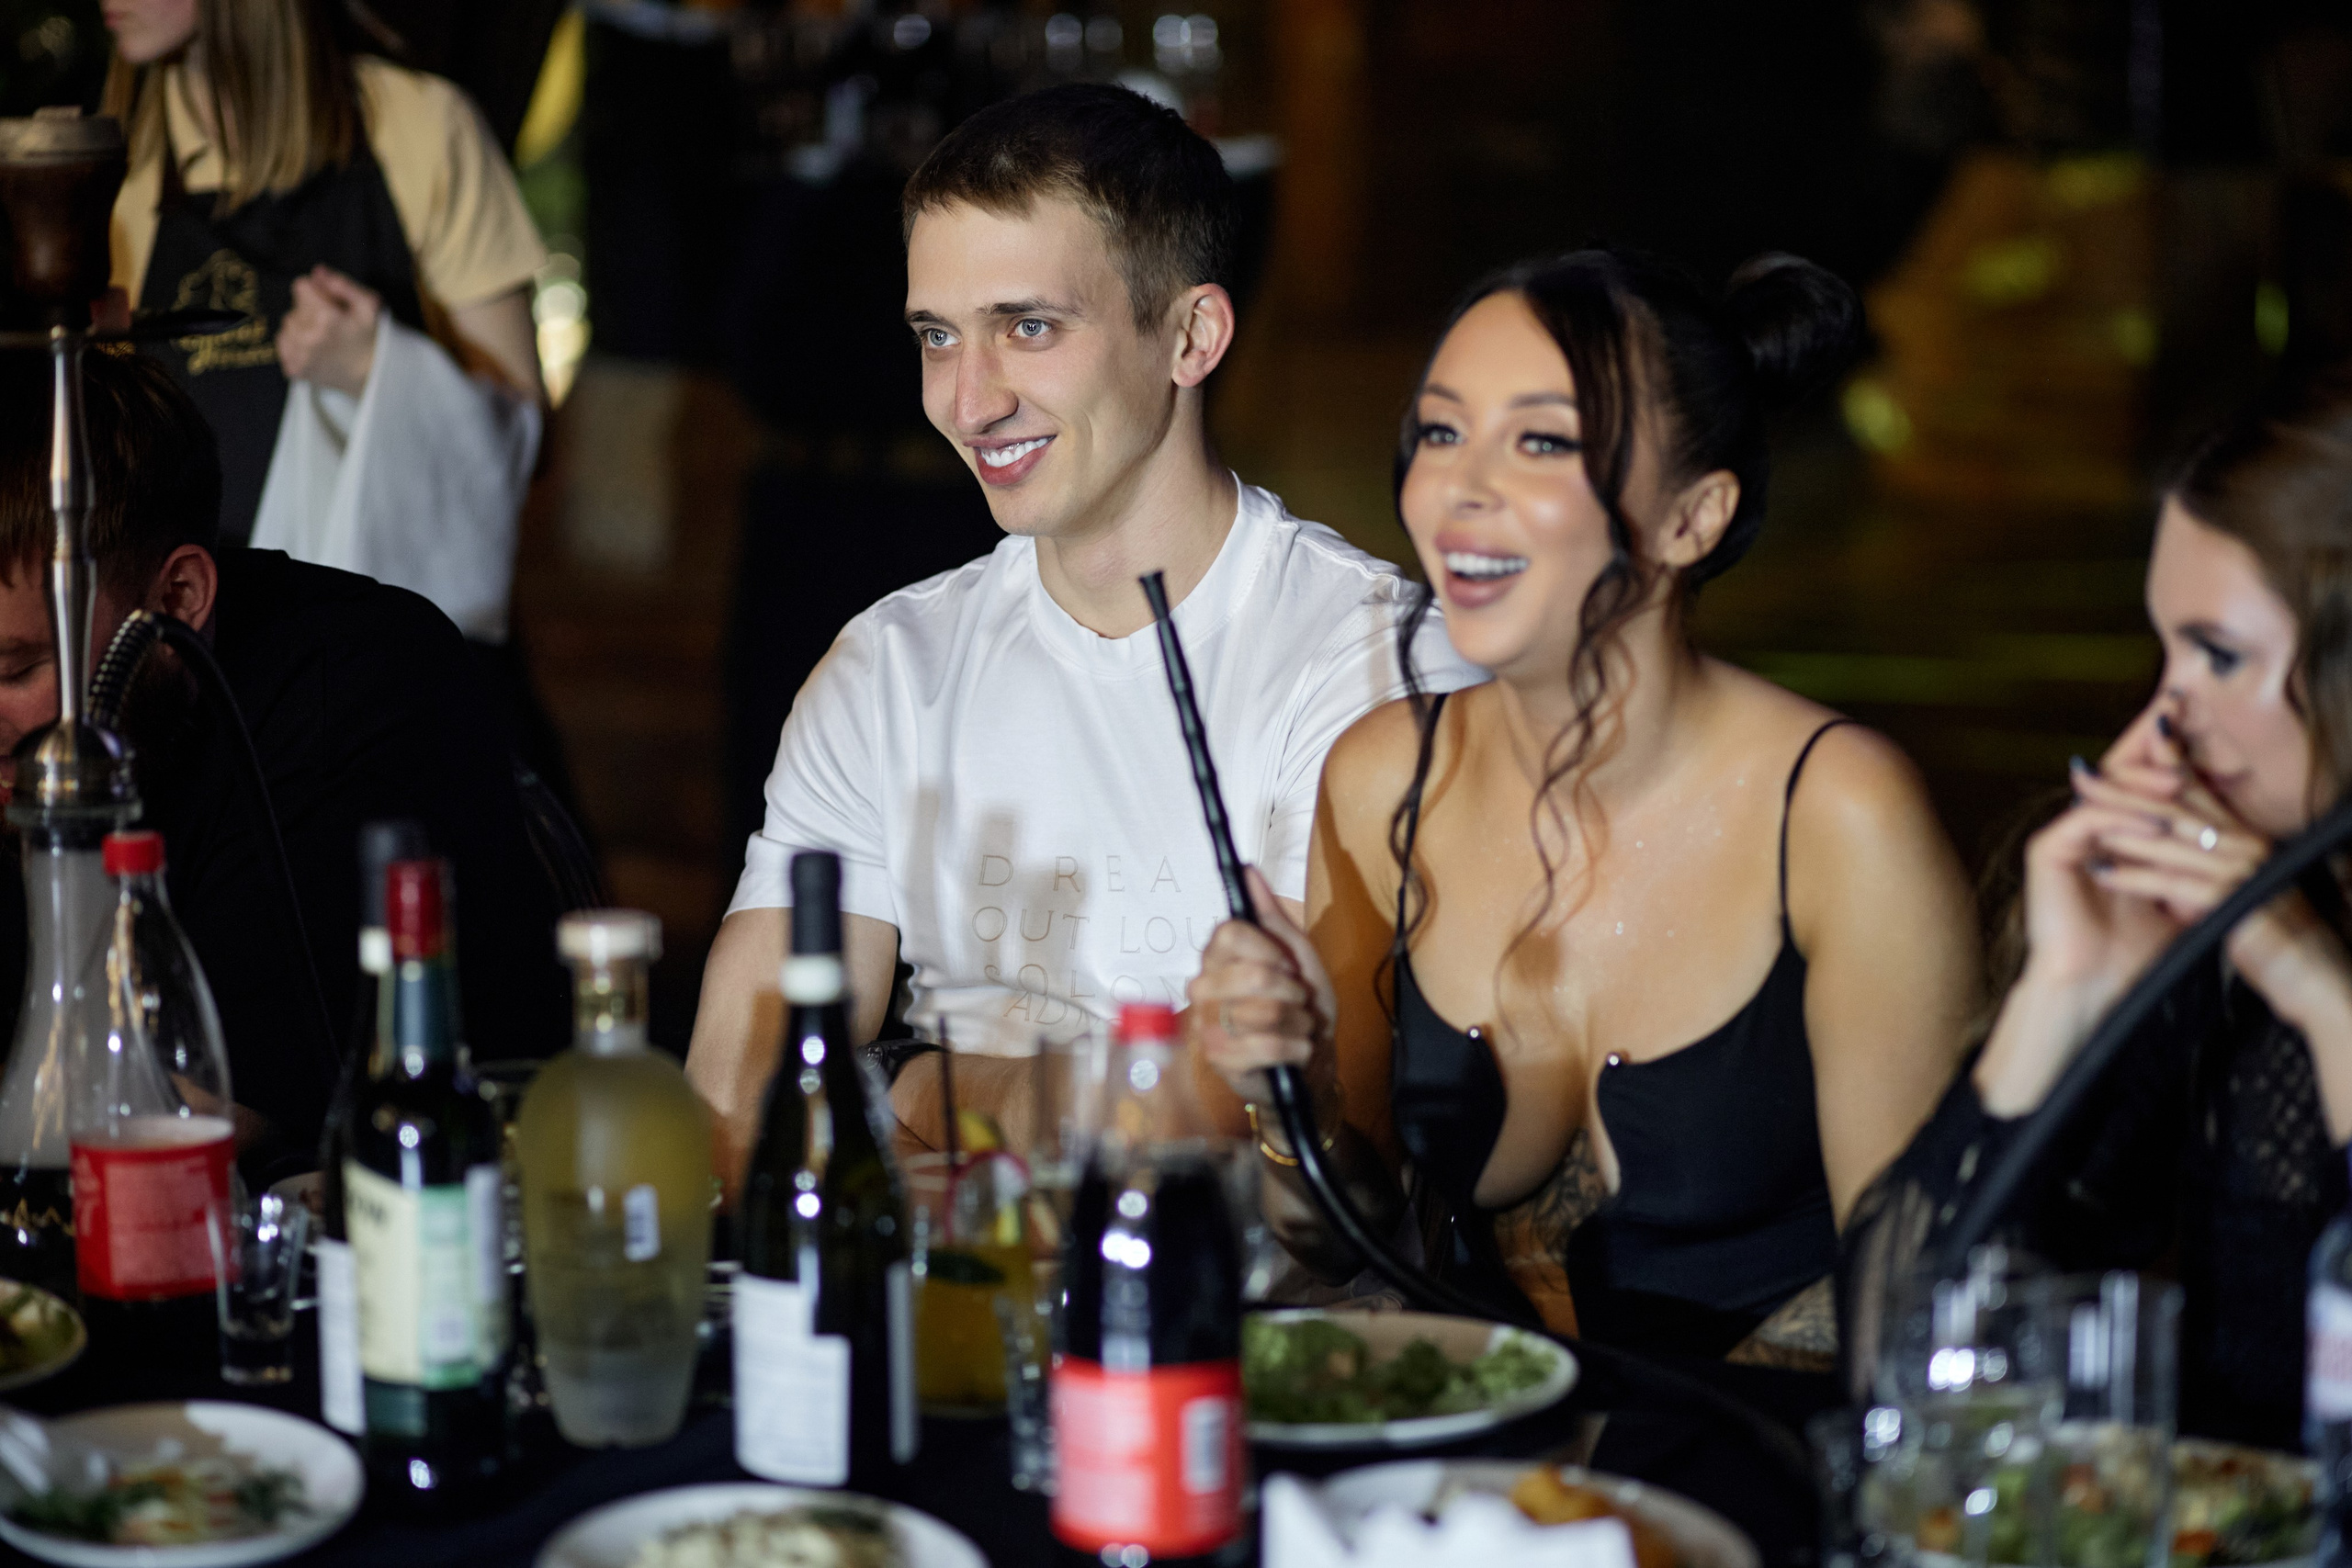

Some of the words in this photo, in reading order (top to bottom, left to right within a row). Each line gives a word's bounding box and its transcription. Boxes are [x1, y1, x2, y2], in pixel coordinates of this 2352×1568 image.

[978, 854, 1227, 893] DREA
[972, 906, 1091, 950] OUT
[1120, 916, 1220, 953] LOU
